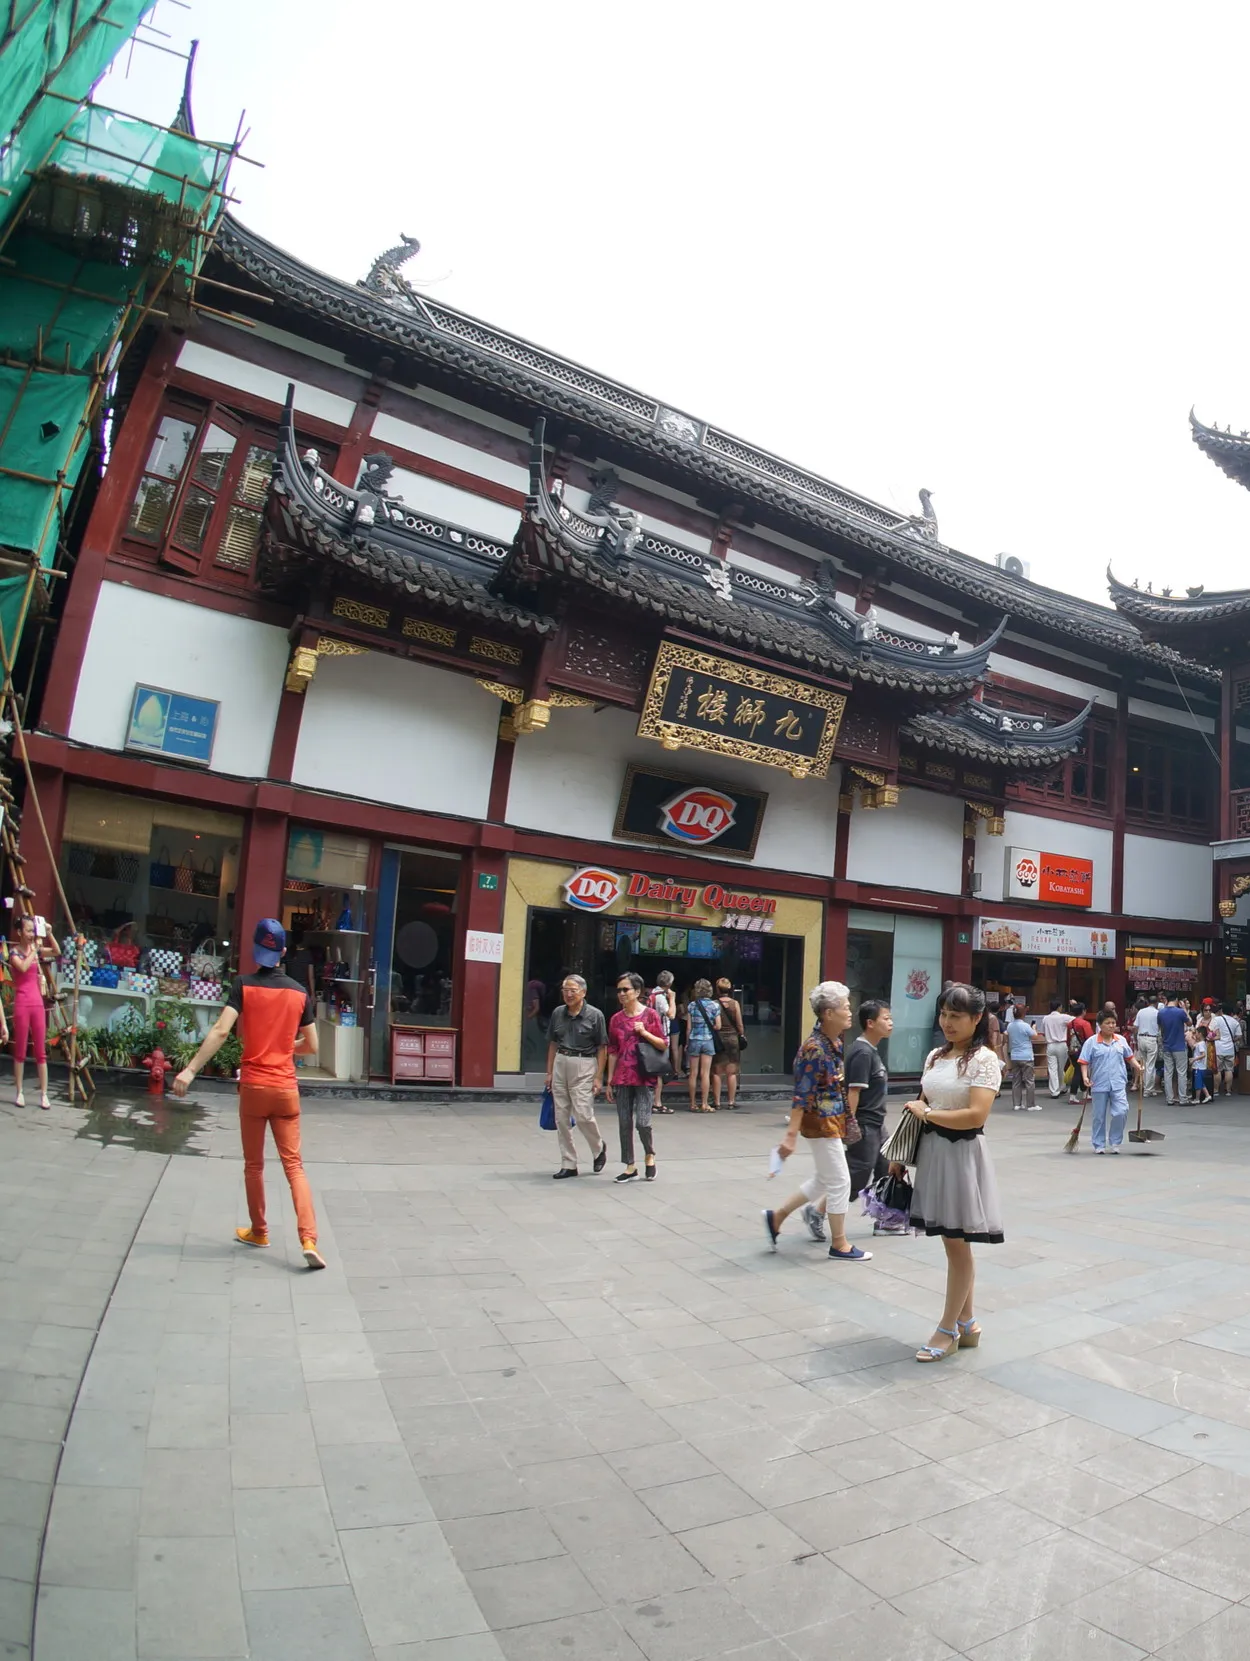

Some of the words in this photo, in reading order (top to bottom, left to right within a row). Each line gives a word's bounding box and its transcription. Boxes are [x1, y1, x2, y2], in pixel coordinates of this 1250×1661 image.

[677, 801, 724, 834] DQ
[486, 876, 491, 884] 7
[577, 877, 613, 902] DQ
[627, 872, 698, 909] Dairy
[702, 883, 777, 913] Queen
[1049, 882, 1084, 895] KOBAYASHI
